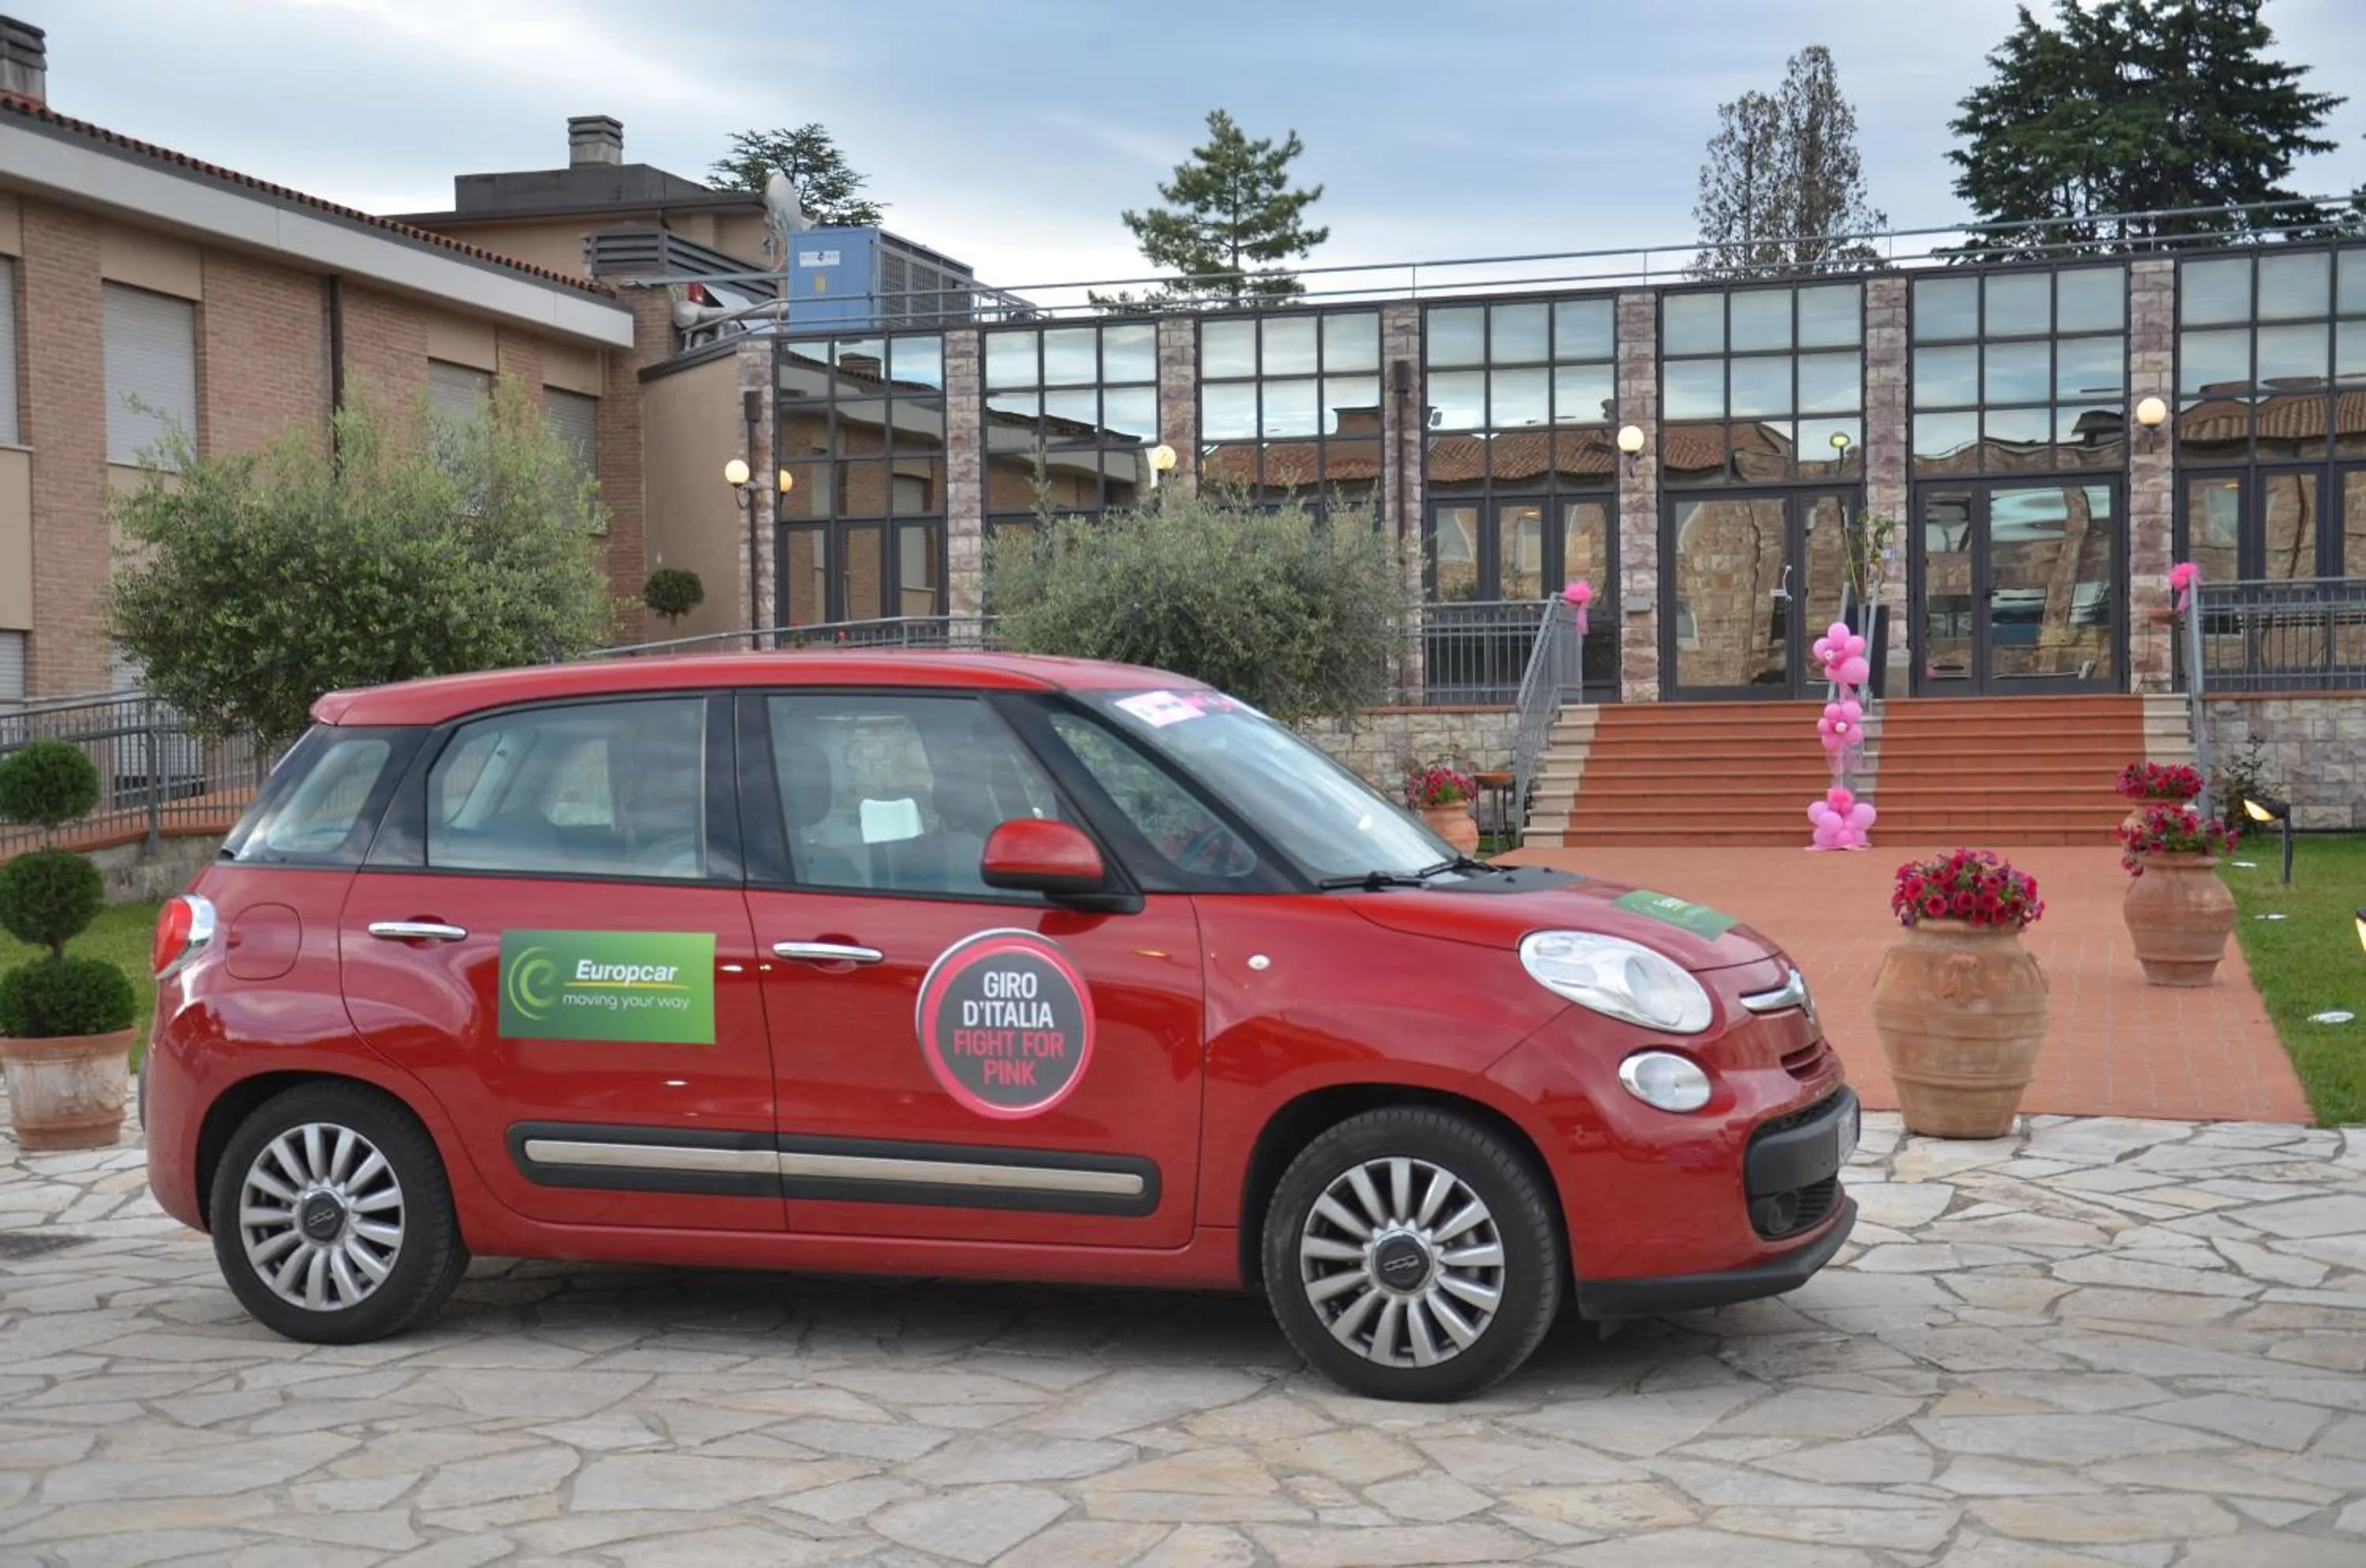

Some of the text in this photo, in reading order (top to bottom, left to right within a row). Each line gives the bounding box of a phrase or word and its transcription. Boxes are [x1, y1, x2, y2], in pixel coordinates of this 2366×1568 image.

[576, 958, 678, 987] Europcar
[983, 971, 1038, 999] GIRO
[562, 993, 690, 1010] moving your way
[962, 999, 1054, 1029] D'ITALIA
[953, 1029, 1065, 1058] FIGHT FOR
[983, 1059, 1037, 1087] PINK
